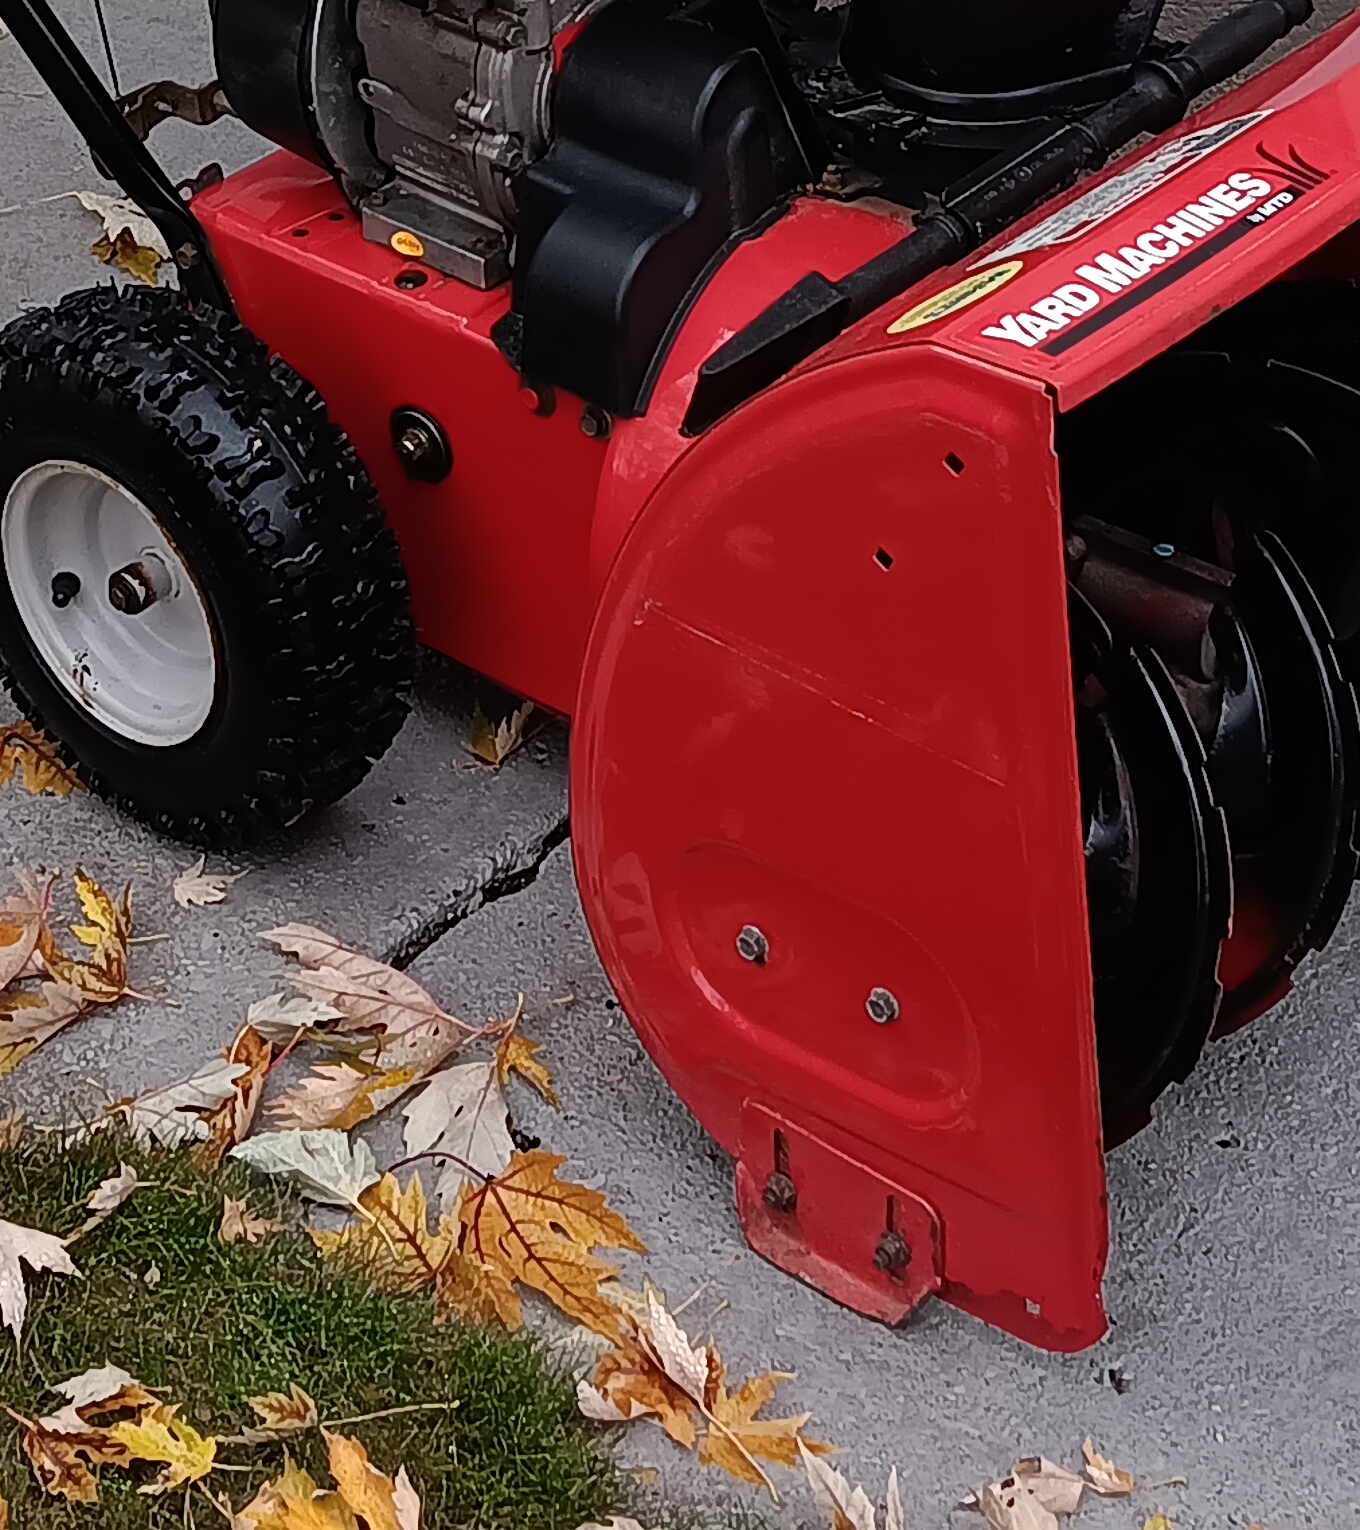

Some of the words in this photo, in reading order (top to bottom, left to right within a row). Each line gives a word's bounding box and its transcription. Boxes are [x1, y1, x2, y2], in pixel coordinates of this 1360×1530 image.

[1257, 191, 1294, 218] MTD
[981, 284, 1100, 348] YARD
[1075, 172, 1272, 294] MACHINES
